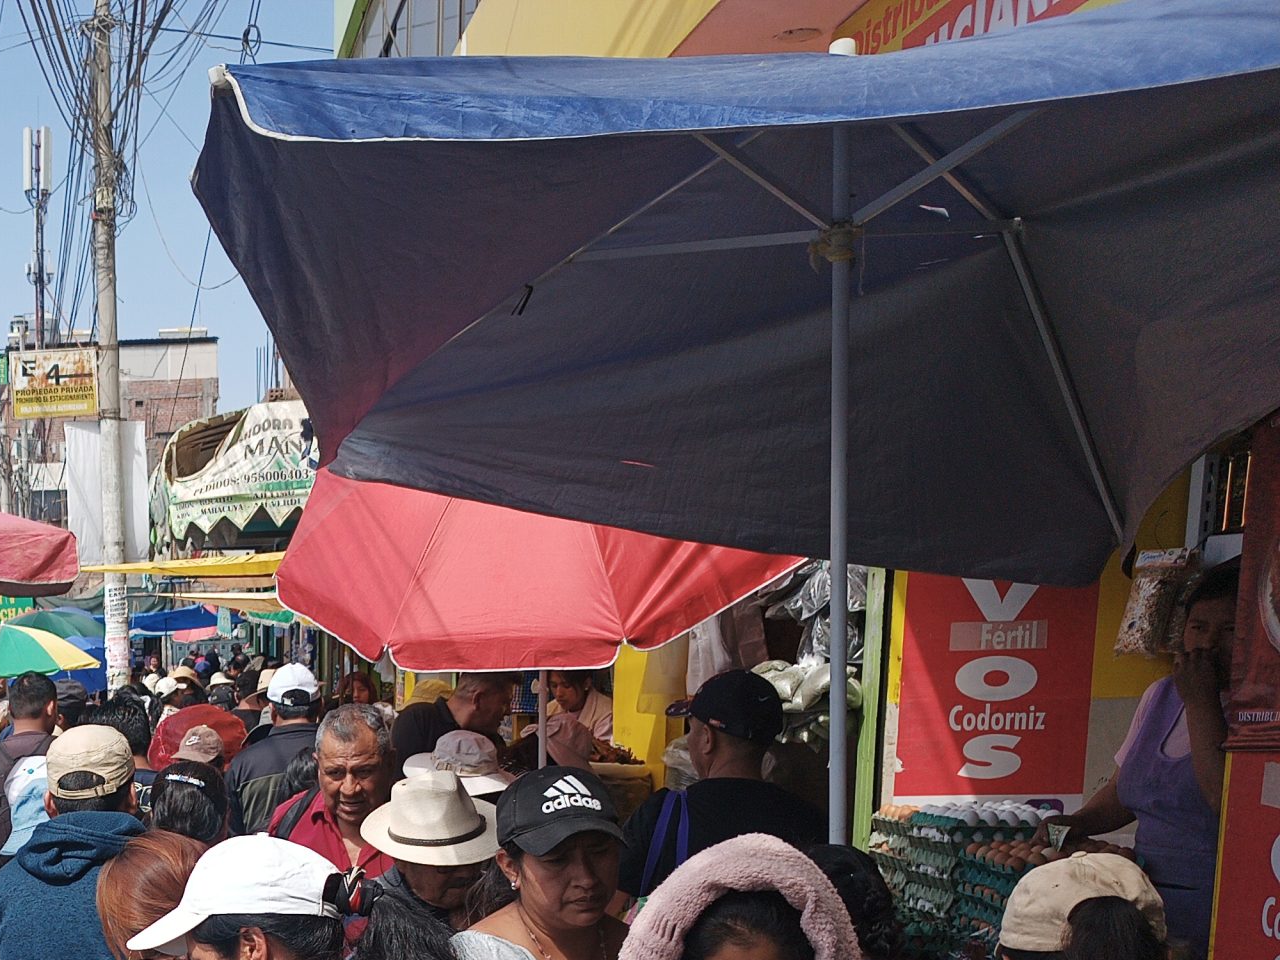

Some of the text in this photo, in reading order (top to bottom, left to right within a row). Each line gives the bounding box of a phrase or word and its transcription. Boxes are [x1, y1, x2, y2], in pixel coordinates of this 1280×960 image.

[15, 385, 94, 396] PROPIEDAD PRIVADA
[980, 624, 1038, 650] Fértil
[949, 704, 1046, 732] Codorniz
[1238, 711, 1280, 723] DISTRIBUI
[541, 793, 602, 814] adidas
